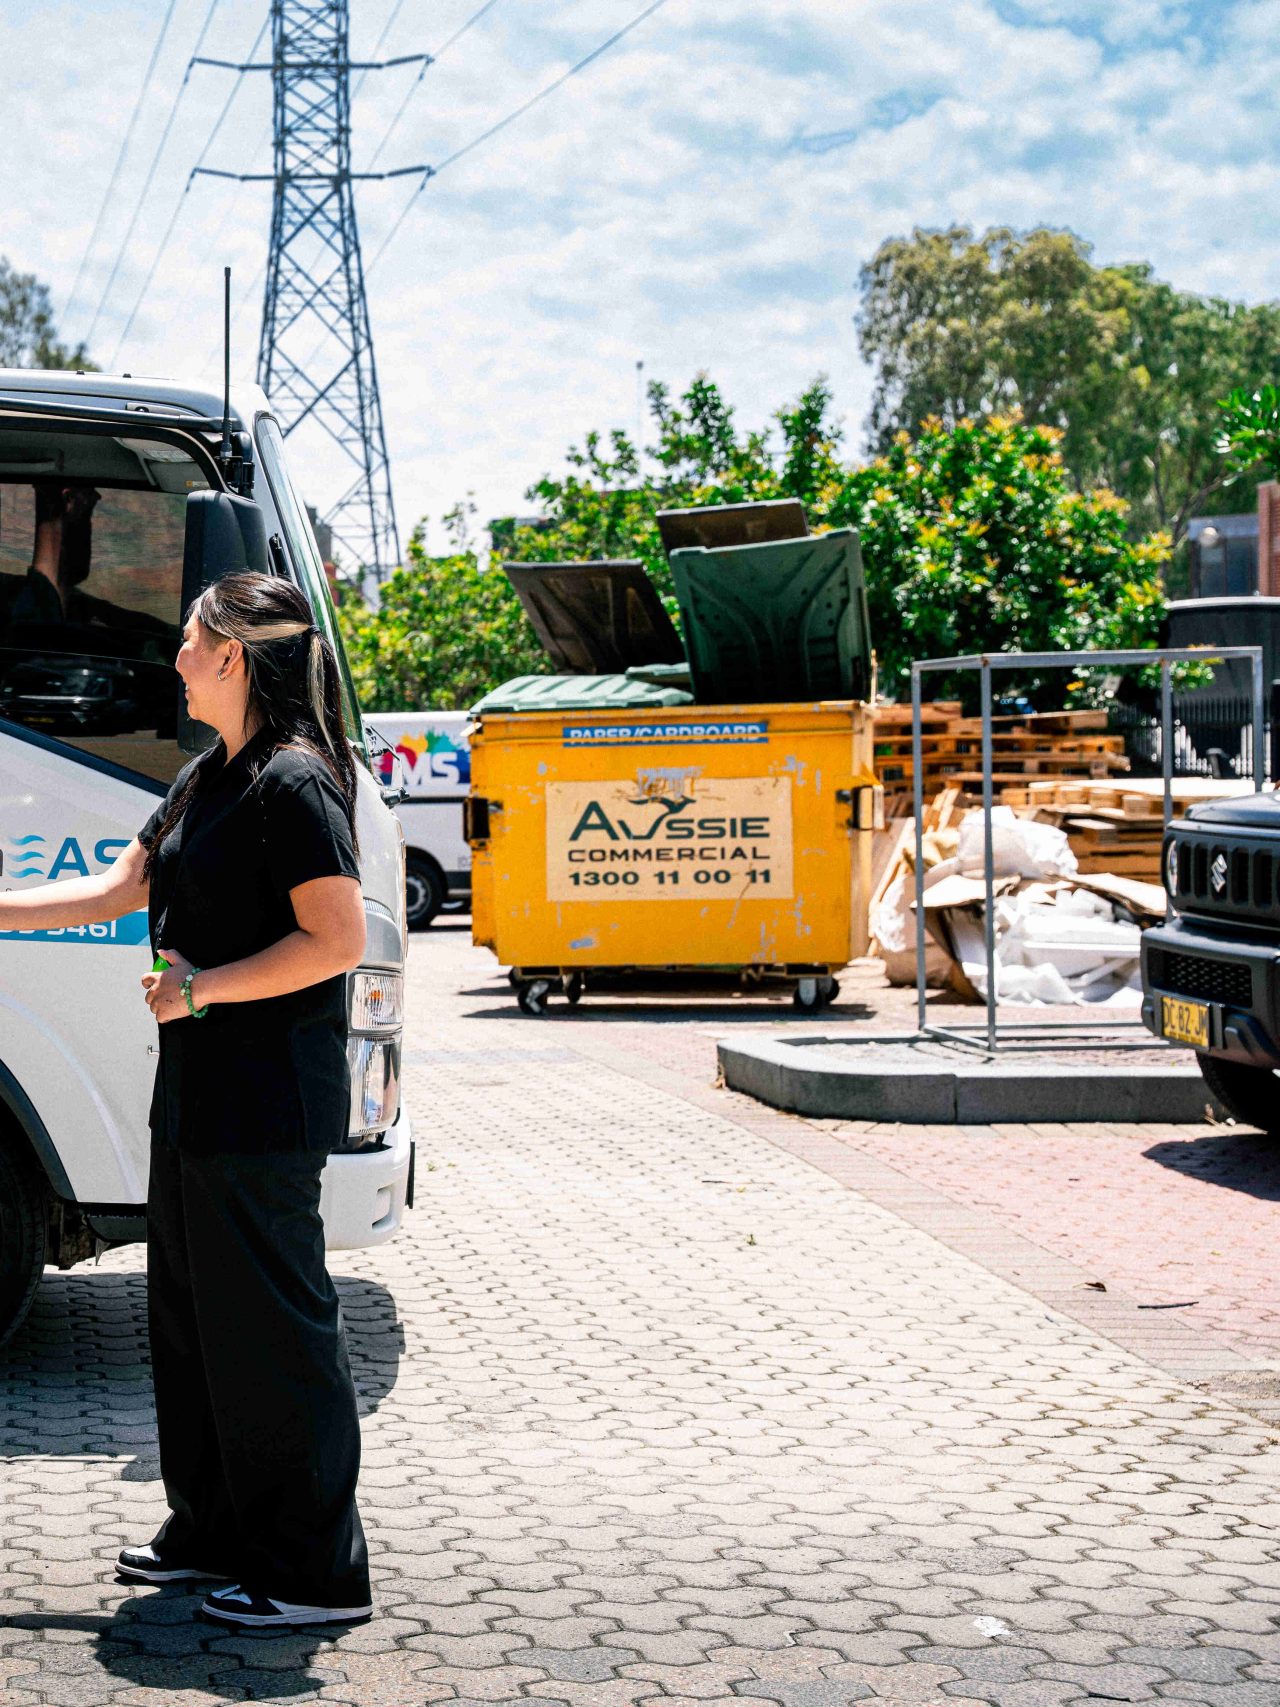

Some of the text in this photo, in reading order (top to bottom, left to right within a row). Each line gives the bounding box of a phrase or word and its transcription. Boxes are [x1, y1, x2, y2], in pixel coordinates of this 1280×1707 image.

[568, 847, 771, 863] COMMERCIAL
[569, 869, 771, 887] 1300 11 00 11
